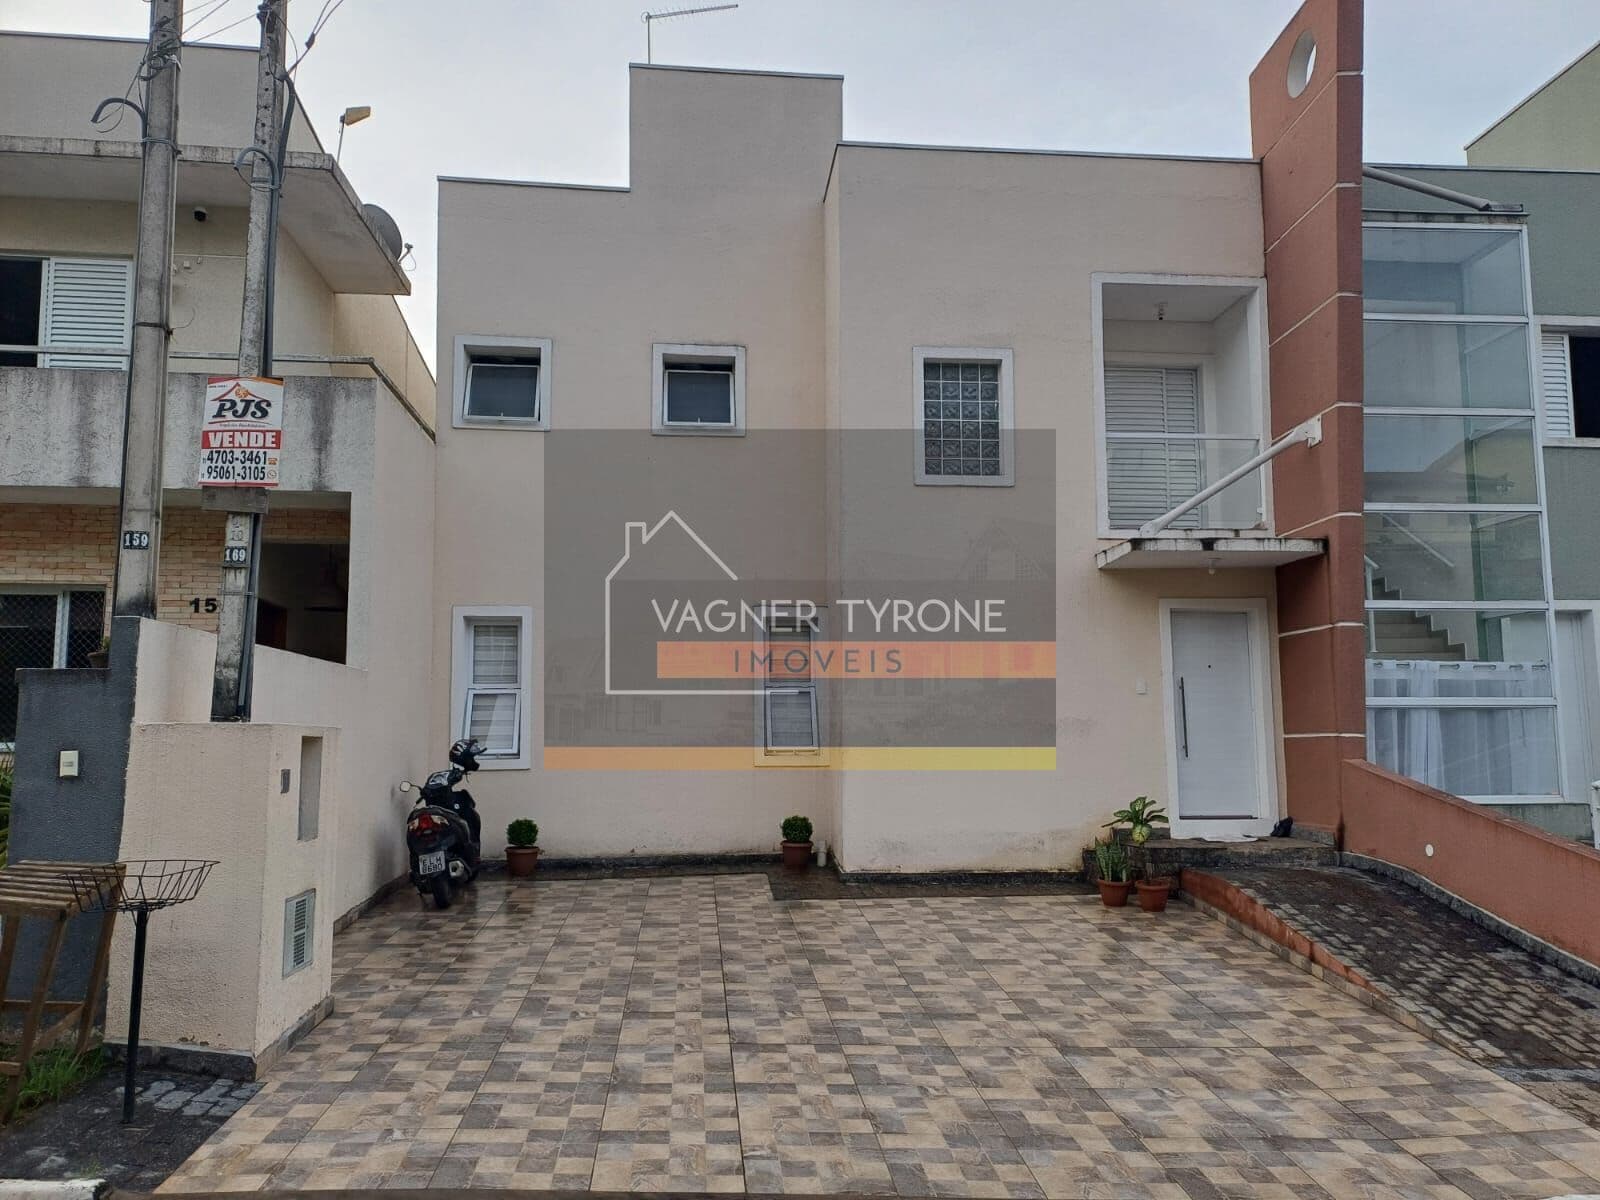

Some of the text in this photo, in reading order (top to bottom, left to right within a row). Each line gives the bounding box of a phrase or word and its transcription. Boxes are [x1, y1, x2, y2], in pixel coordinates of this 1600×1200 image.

[212, 398, 272, 419] PJS
[208, 431, 276, 448] VENDE
[207, 450, 267, 465] 4703-3461
[207, 465, 266, 480] 95061-3105
[124, 533, 149, 547] 159
[225, 548, 246, 562] 169
